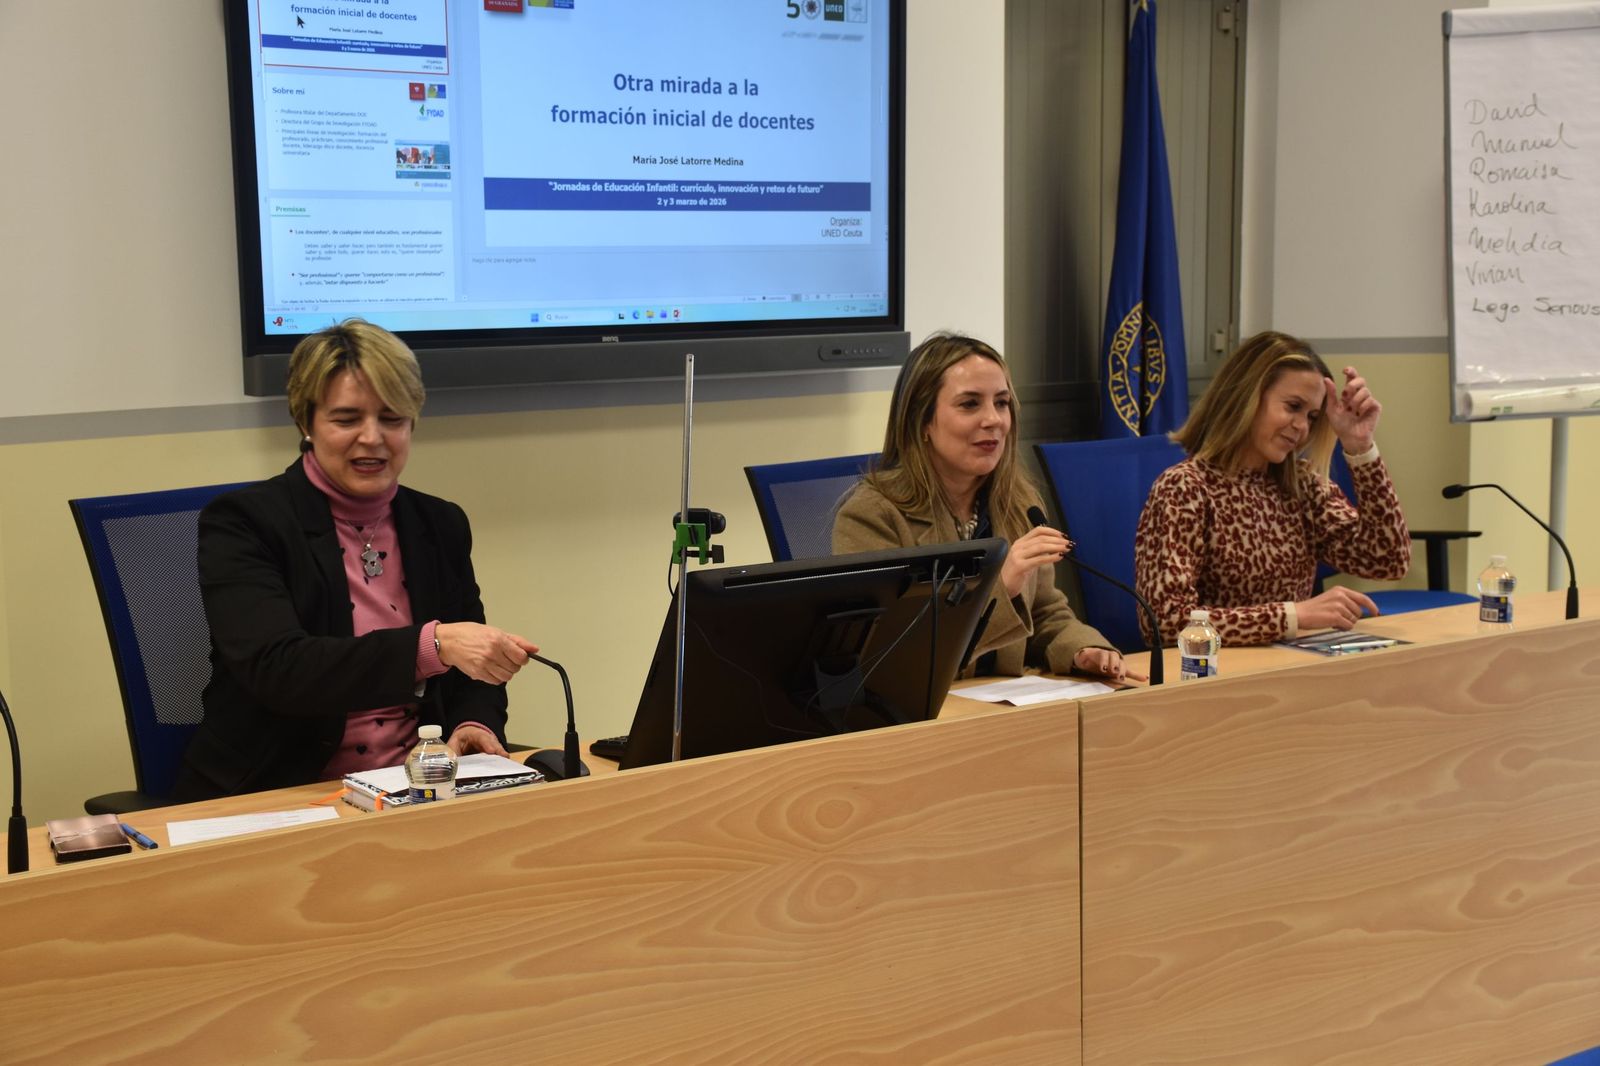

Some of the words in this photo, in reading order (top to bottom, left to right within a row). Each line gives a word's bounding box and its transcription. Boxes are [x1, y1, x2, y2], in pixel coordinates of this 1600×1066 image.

[291, 4, 336, 15] formación
[338, 8, 364, 17] inicial
[379, 11, 416, 20] docentes
[614, 73, 654, 92] Otra
[660, 76, 722, 94] mirada
[728, 82, 738, 96] a
[744, 78, 758, 96] la
[551, 105, 646, 125] formación
[652, 109, 705, 127] inicial
[712, 110, 732, 128] de
[738, 112, 814, 130] docentes
[1464, 92, 1548, 125] David
[1471, 122, 1580, 154] Manuel
[659, 156, 678, 165] José
[680, 156, 712, 166] Latorre
[714, 157, 744, 166] Medina
[592, 182, 602, 192] de
[604, 182, 645, 192] Educación
[646, 182, 679, 192] Infantil:
[680, 183, 716, 194] currículo,
[718, 184, 758, 193] innovación
[760, 186, 766, 195] y
[766, 184, 786, 194] retos
[787, 184, 796, 194] de
[657, 198, 662, 206] 2
[664, 198, 668, 206] y
[669, 198, 674, 206] 3
[699, 198, 708, 206] de
[709, 198, 727, 206] 2026
[1468, 187, 1558, 218] Karolina
[821, 229, 842, 238] UNED
[842, 229, 863, 238] Ceuta
[1472, 297, 1520, 323] Lego
